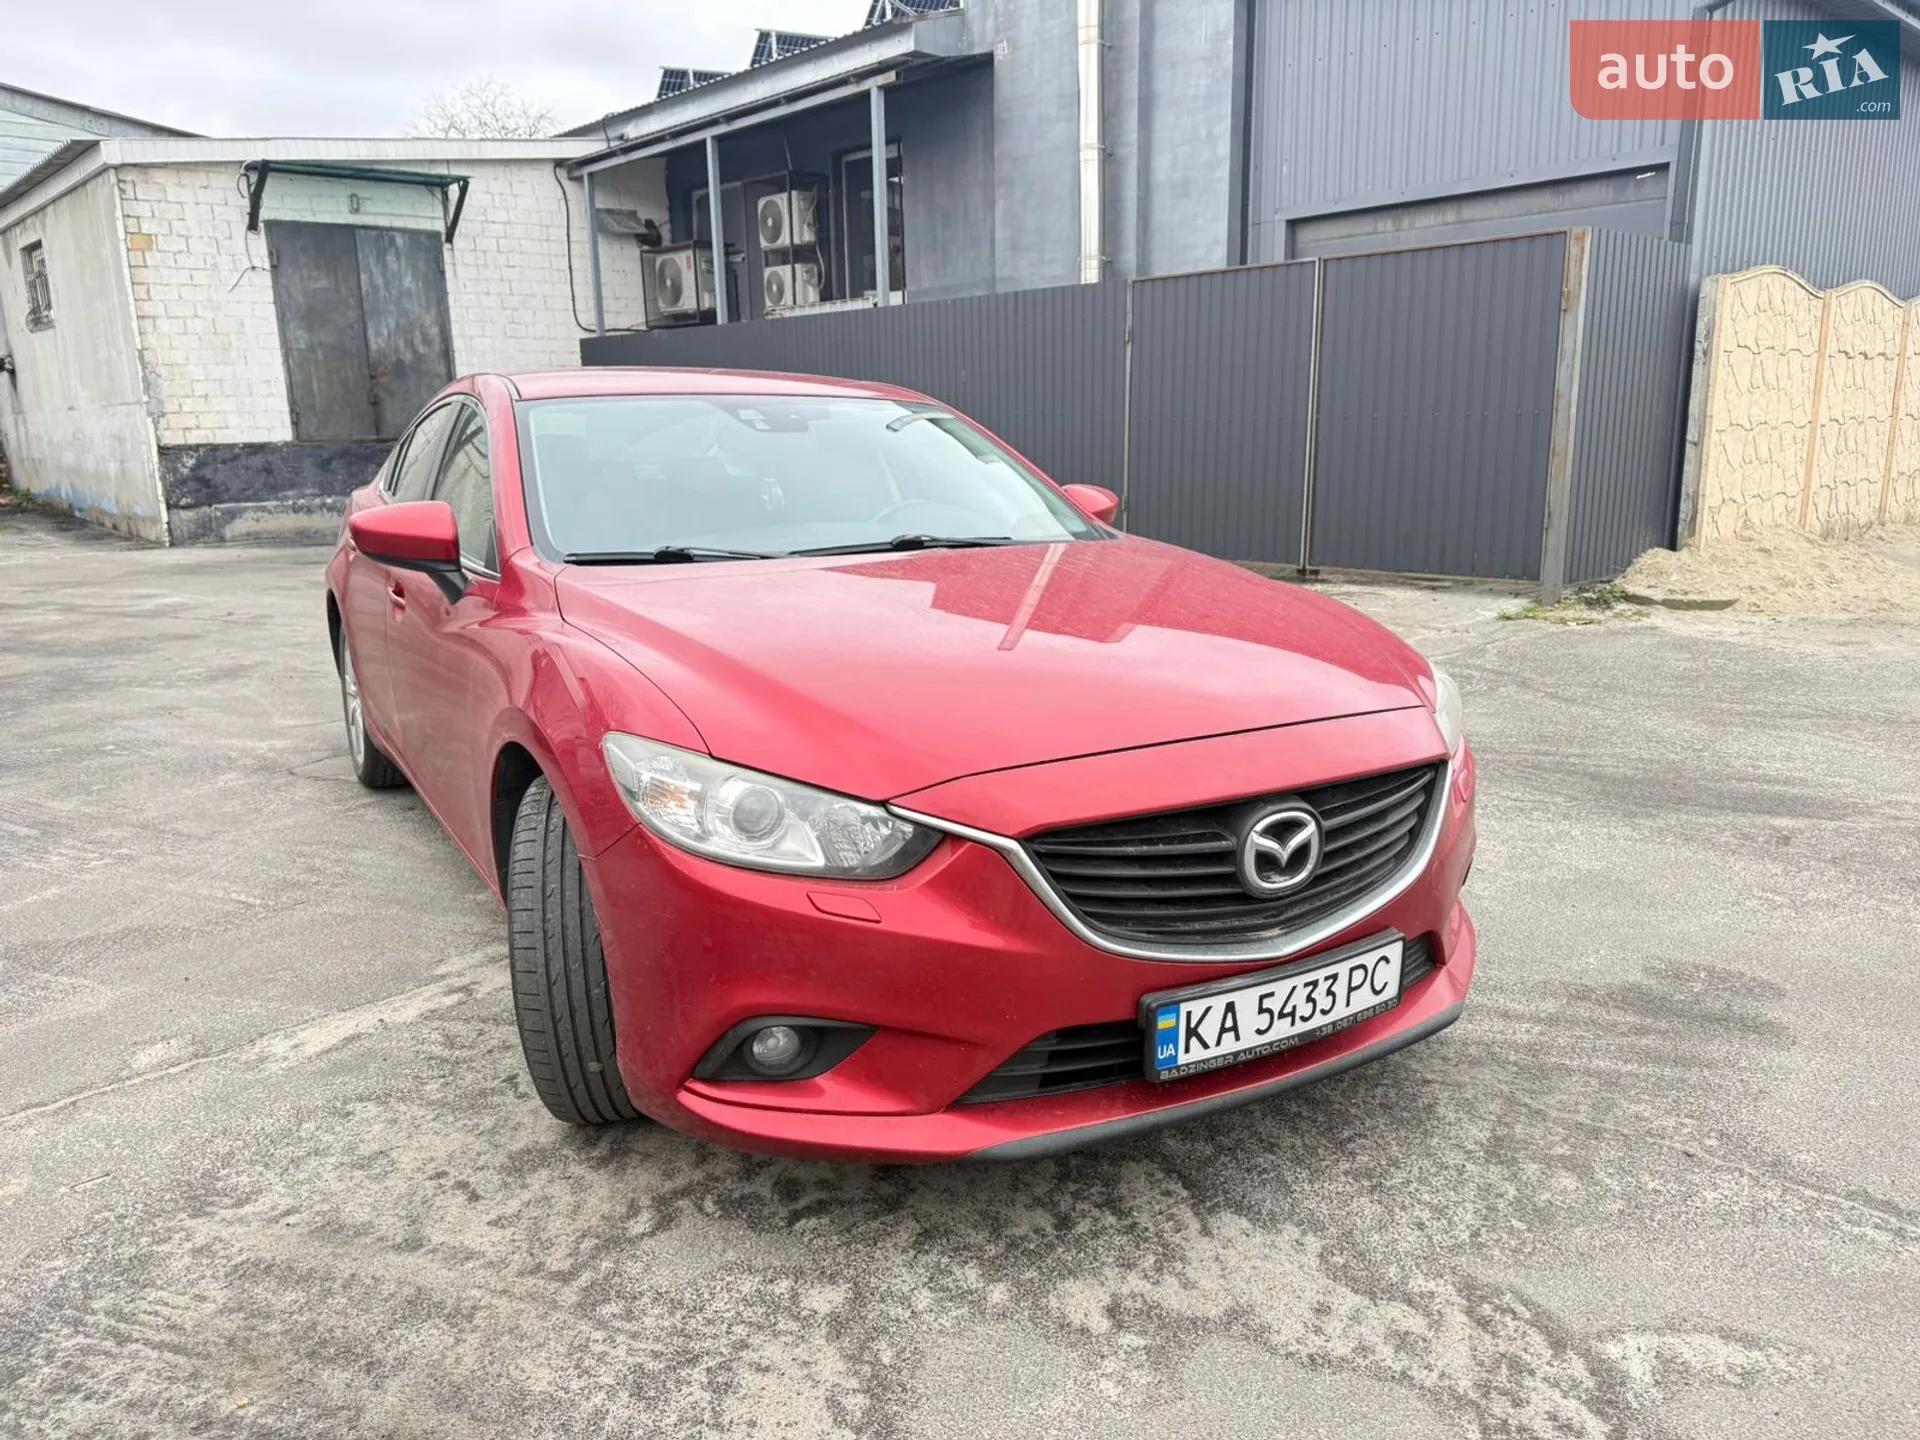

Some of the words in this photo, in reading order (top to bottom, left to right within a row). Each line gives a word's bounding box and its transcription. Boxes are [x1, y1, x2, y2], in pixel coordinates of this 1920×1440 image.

[1183, 1000, 1241, 1054] KA
[1254, 971, 1340, 1036] 5433
[1345, 955, 1391, 1008] PC
[1157, 1045, 1176, 1060] UA
